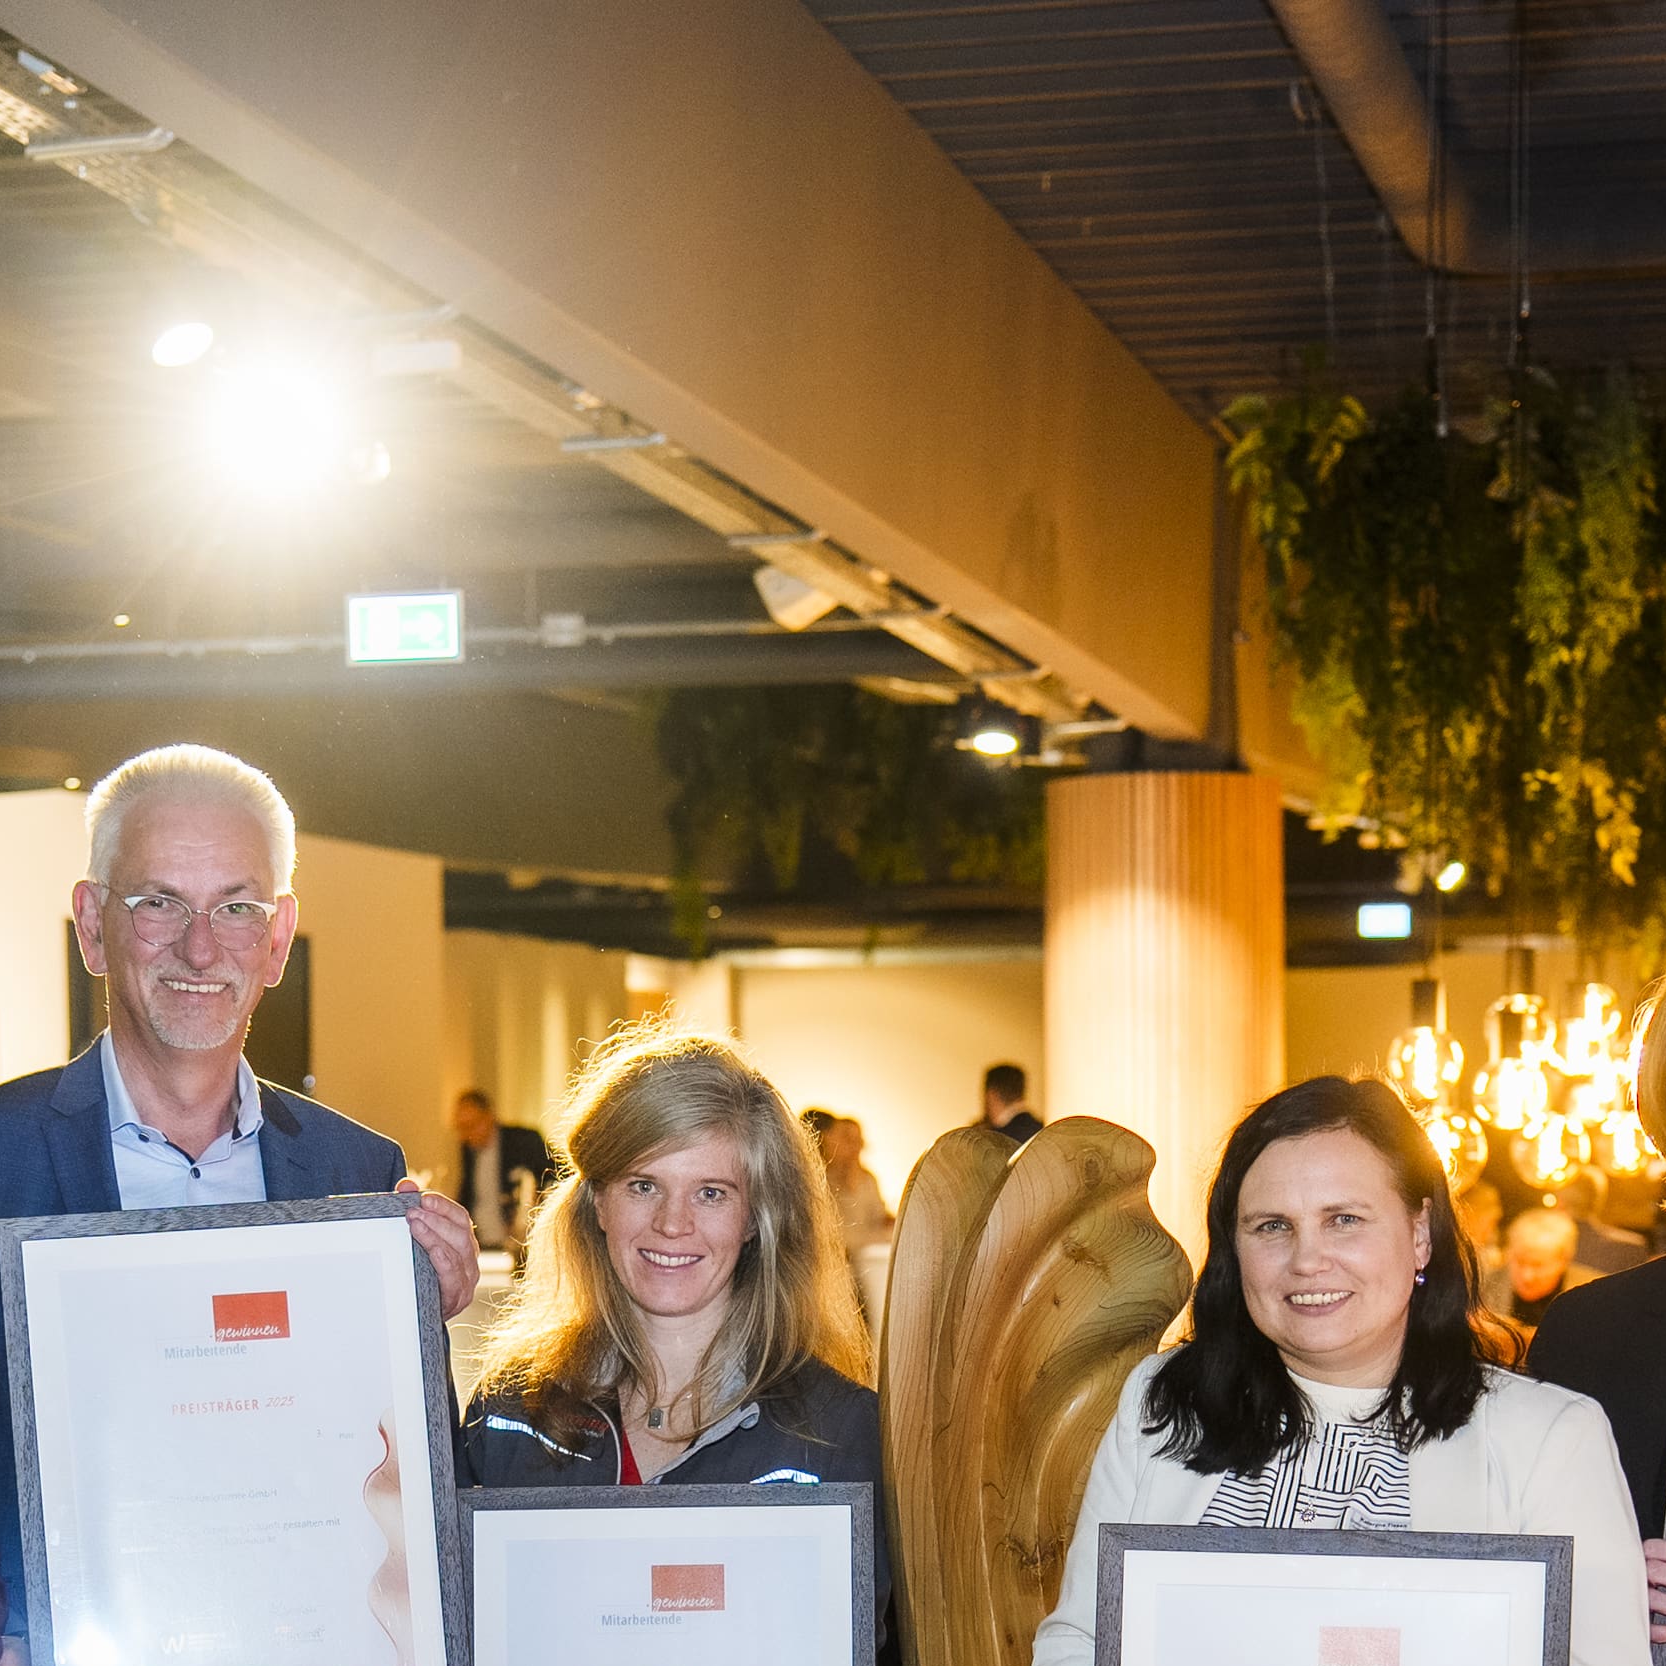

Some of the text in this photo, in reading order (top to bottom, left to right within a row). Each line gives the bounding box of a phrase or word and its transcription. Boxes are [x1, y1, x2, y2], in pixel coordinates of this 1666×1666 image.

[215, 1324, 281, 1342] gewinnen
[164, 1342, 248, 1361] Mitarbeitende
[172, 1395, 295, 1417] PREISTRÄGER 2025
[325, 1517, 341, 1528] mit
[652, 1597, 716, 1612] gewinnen
[601, 1612, 683, 1627] Mitarbeitende
